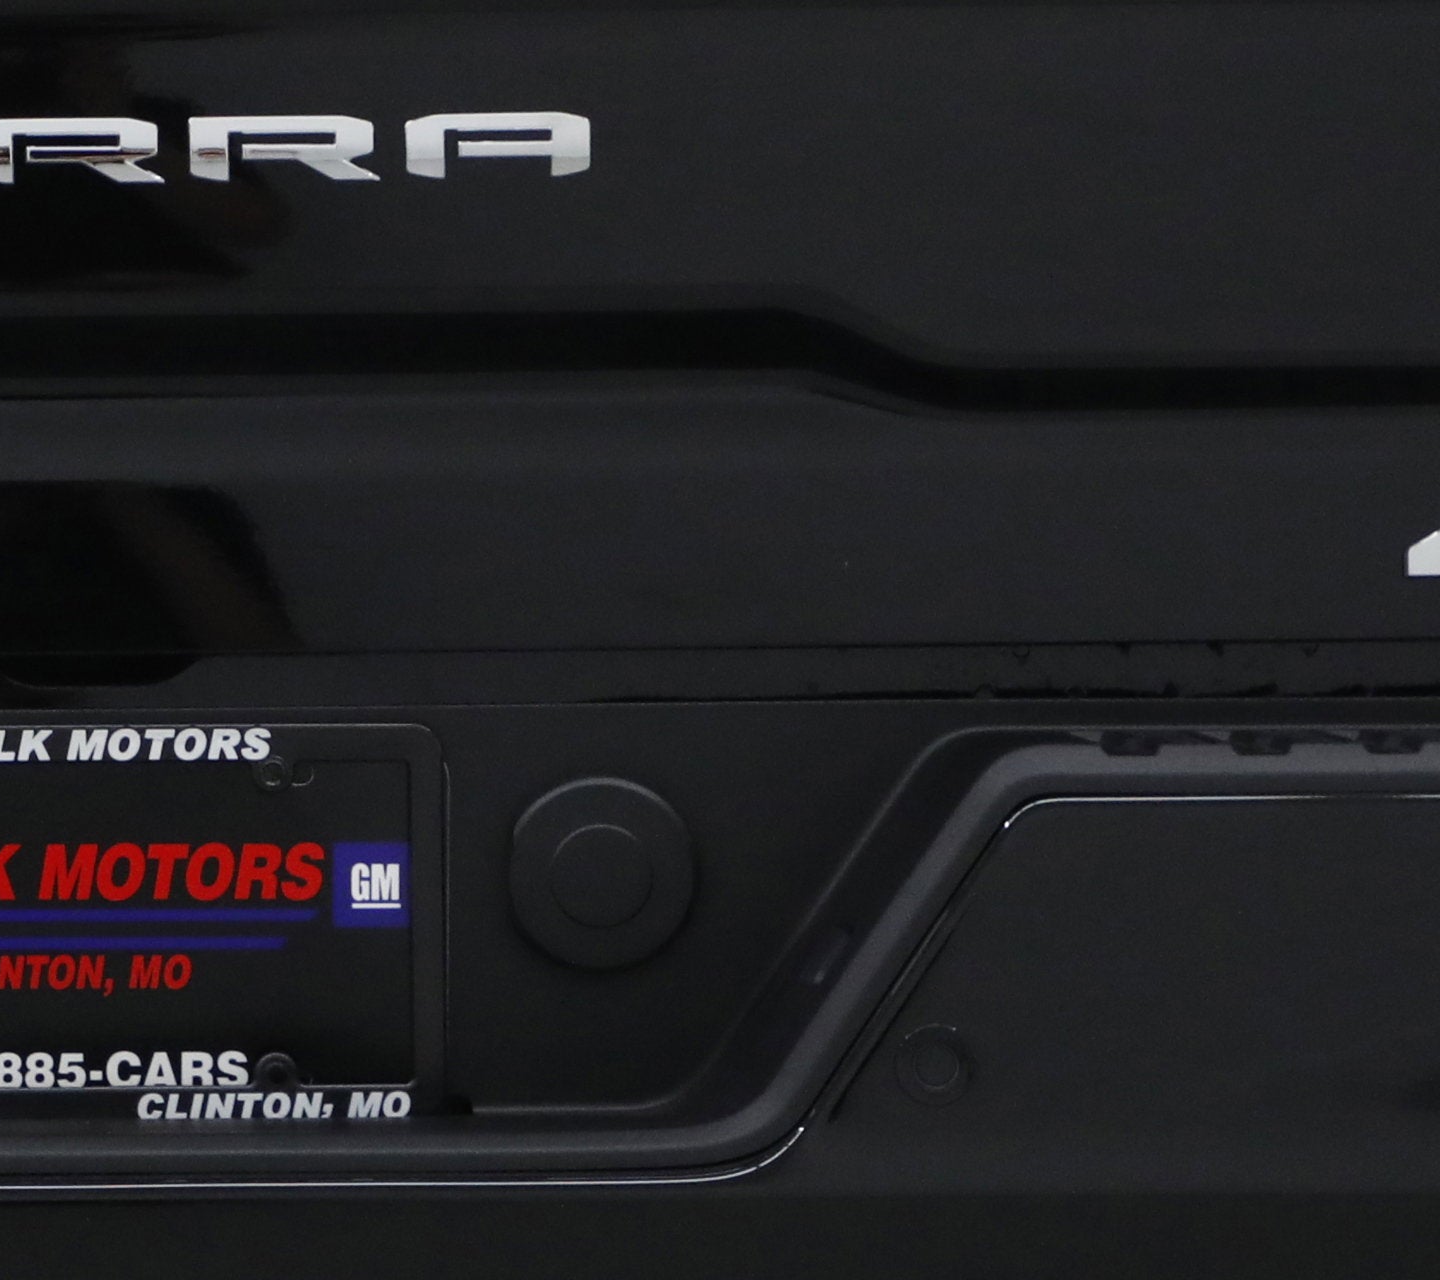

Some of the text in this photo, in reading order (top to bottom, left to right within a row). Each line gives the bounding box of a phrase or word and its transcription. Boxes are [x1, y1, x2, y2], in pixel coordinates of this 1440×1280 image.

[67, 726, 271, 761] MOTORS
[38, 842, 325, 901] MOTORS
[351, 863, 399, 901] GM
[129, 954, 192, 990] MO
[137, 1091, 410, 1120] CLINTON, MO
